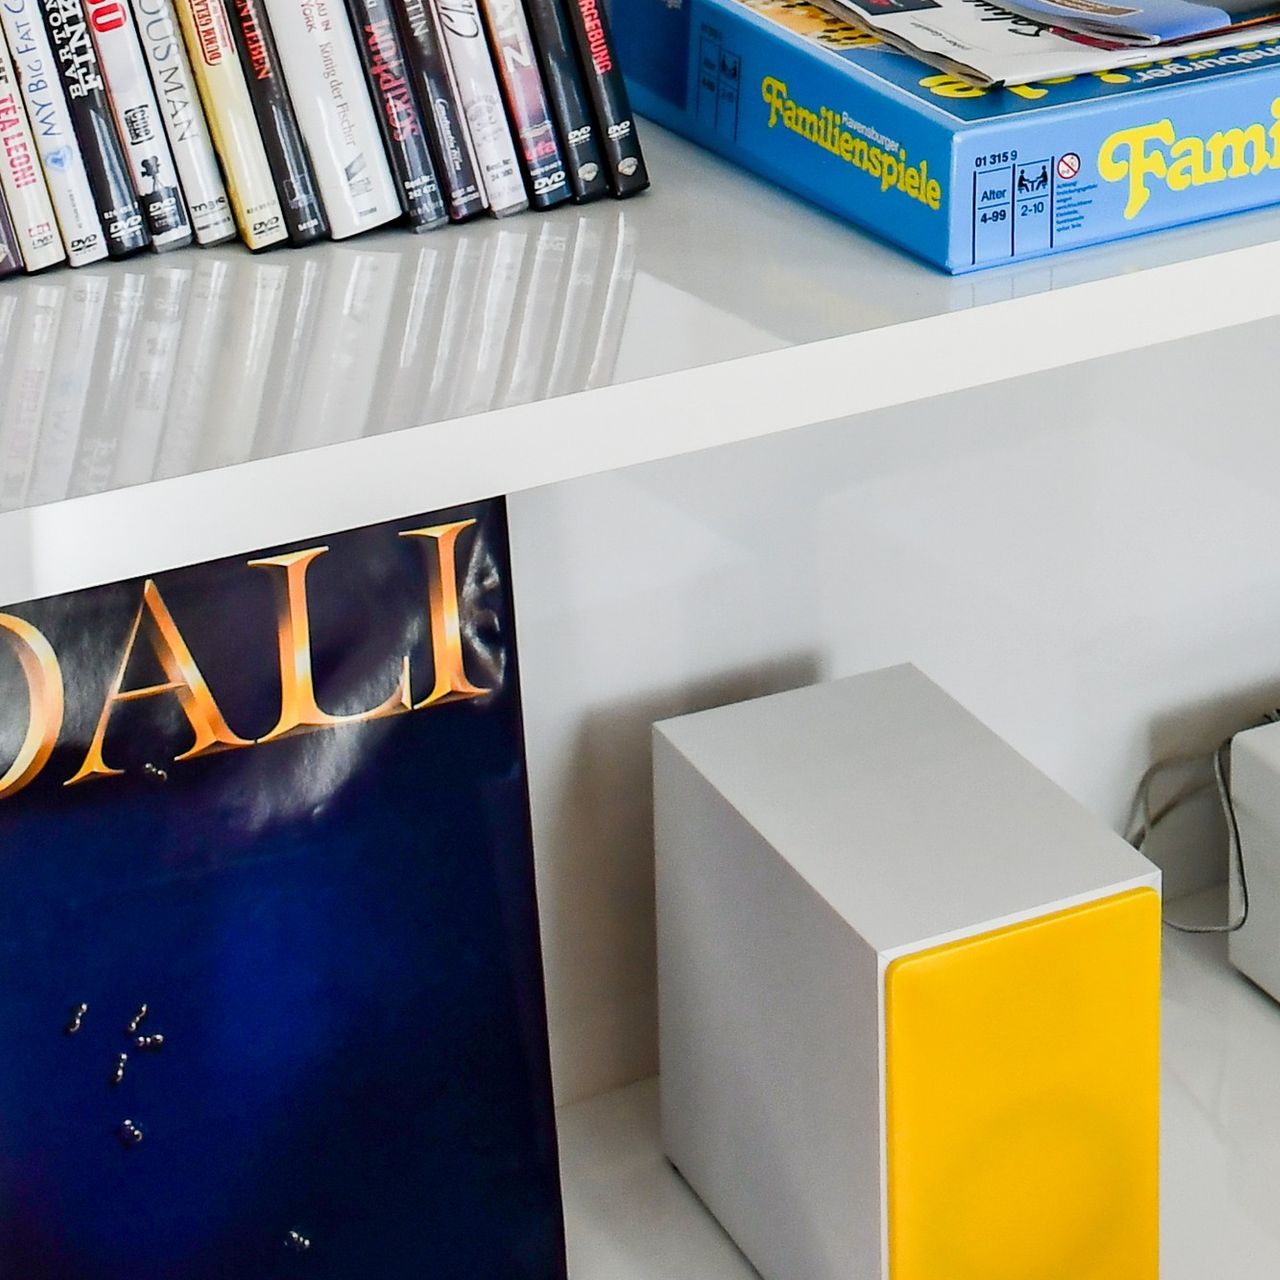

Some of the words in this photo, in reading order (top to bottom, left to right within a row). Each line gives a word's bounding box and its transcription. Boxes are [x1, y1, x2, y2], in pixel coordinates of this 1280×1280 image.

[301, 0, 318, 33] YORK
[15, 20, 37, 54] FAT
[201, 24, 223, 63] DUMM
[240, 20, 273, 81] LEBEN
[27, 59, 49, 94] BIG
[319, 42, 340, 80] König
[159, 65, 198, 145] MAN
[329, 79, 346, 101] der
[32, 98, 63, 137] MY
[608, 120, 631, 135] DVD
[842, 111, 899, 153] Ravensburger
[4, 131, 37, 189] LEONI
[761, 76, 942, 211] Familienspiele
[534, 170, 566, 190] DVD
[981, 188, 1007, 202] Alter
[980, 209, 1007, 224] 4-99
[1021, 201, 1045, 216] 2-10
[0, 519, 492, 799] DALI
